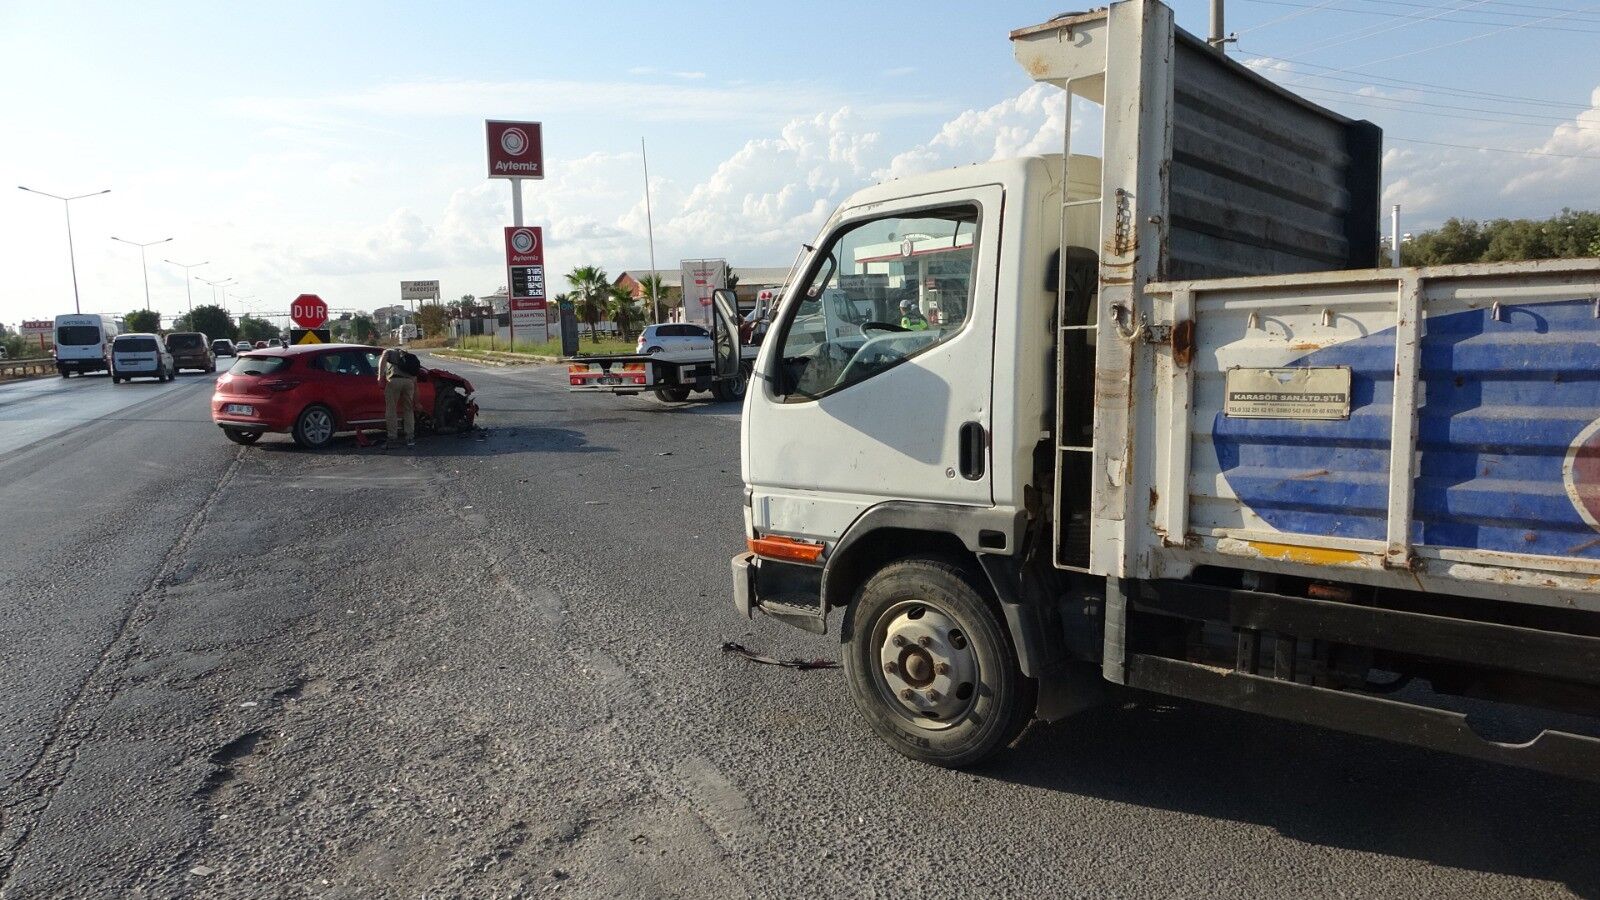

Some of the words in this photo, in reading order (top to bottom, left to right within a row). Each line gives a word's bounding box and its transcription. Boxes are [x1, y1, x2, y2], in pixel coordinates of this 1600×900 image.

[495, 160, 538, 172] Aytemiz
[512, 254, 539, 262] Aytemiz
[294, 305, 325, 319] DUR
[1233, 393, 1279, 401] KARASÖR
